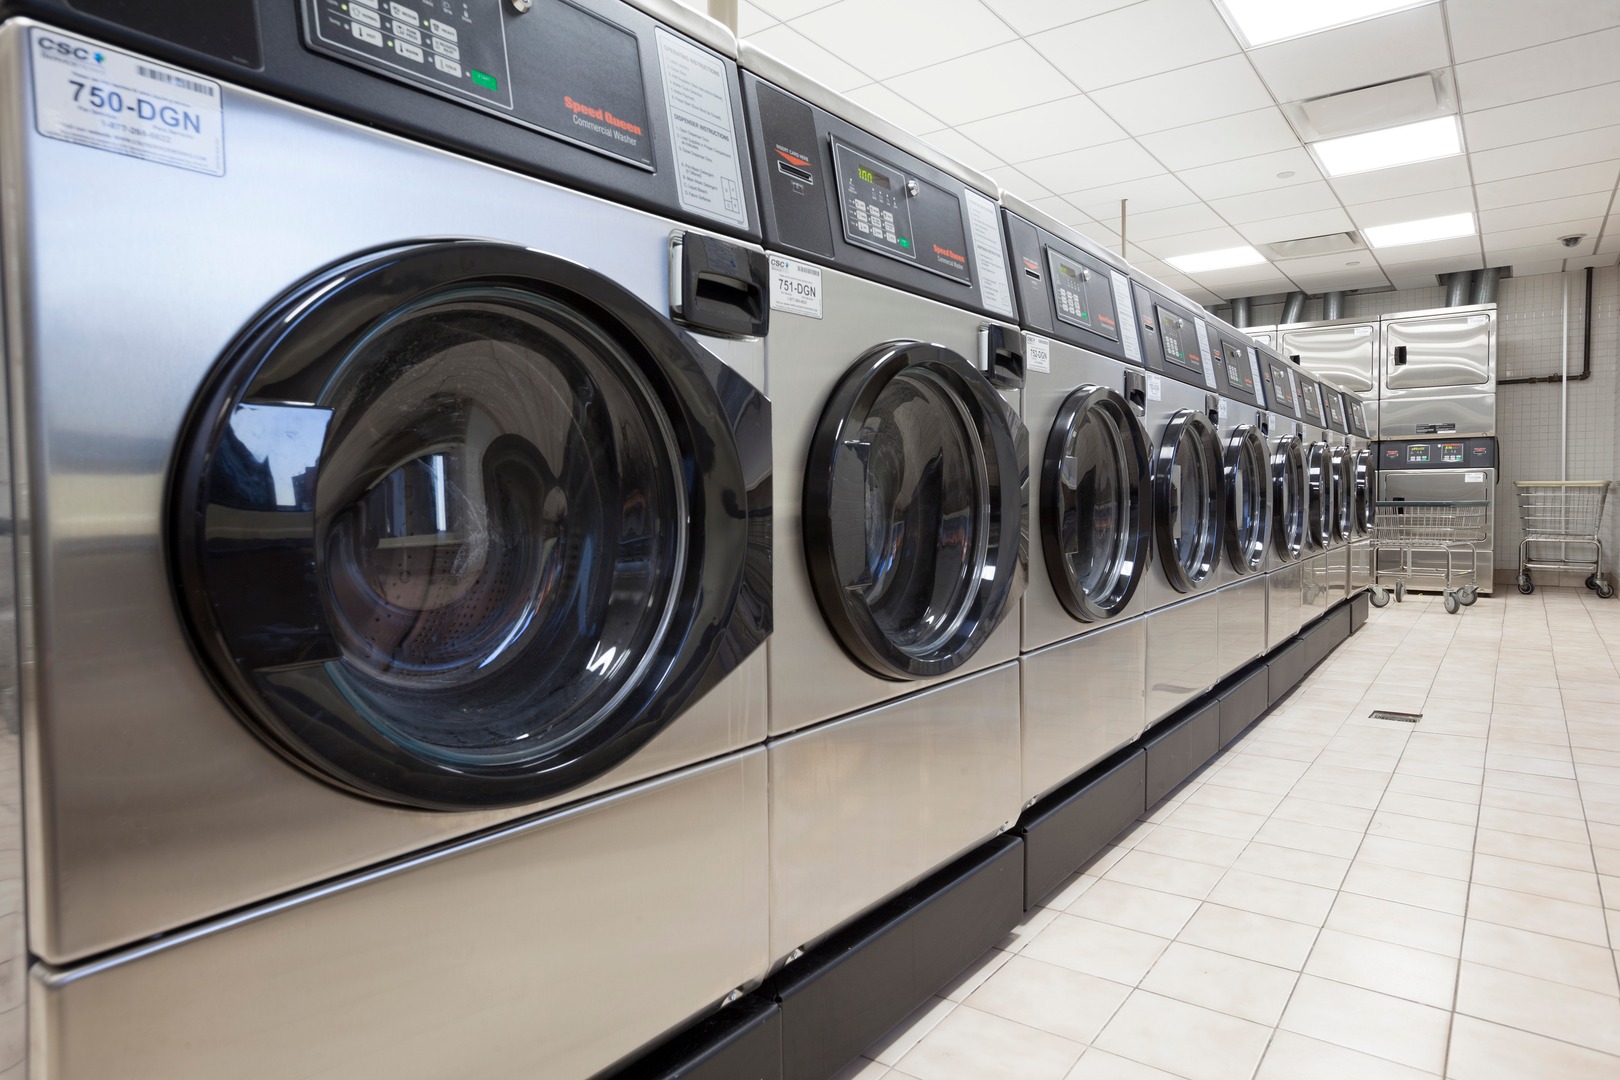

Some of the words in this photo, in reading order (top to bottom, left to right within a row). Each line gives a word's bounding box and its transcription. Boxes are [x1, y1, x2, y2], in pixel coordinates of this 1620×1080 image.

[38, 37, 89, 60] CSC
[68, 80, 200, 134] 750-DGN
[564, 95, 603, 121] Speed
[604, 111, 641, 135] Queen
[573, 114, 612, 137] Commercial
[613, 130, 637, 146] Washer
[771, 259, 785, 268] CSC
[778, 278, 816, 298] 751-DGN
